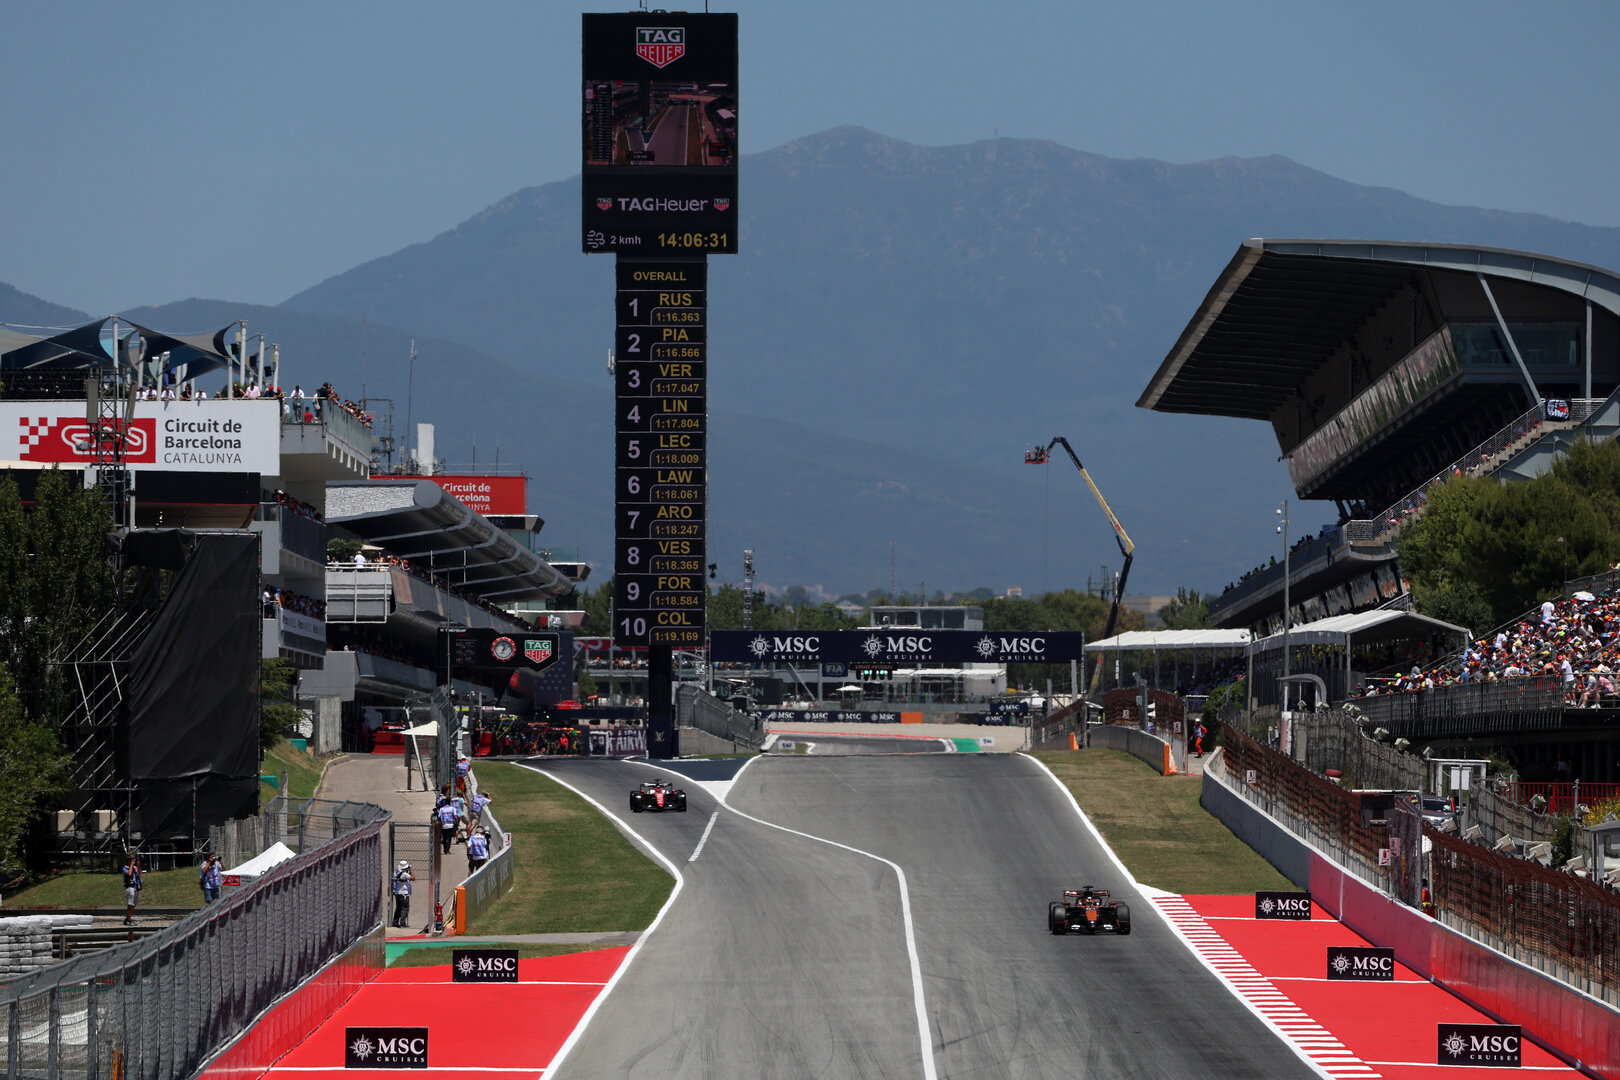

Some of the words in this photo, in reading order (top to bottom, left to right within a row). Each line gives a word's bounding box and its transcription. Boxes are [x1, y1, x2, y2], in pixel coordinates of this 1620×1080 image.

[640, 30, 681, 42] TAG
[639, 46, 682, 64] HEUER
[610, 236, 617, 244] 2
[619, 235, 641, 245] kmh
[658, 233, 727, 247] 14:06:31
[633, 272, 687, 281] OVERALL
[628, 298, 638, 317] 1
[660, 293, 692, 306] RUS
[656, 313, 700, 322] 1:16.363
[628, 334, 640, 352] 2
[663, 328, 688, 341] PIA
[656, 348, 700, 357] 1:16.566
[628, 370, 640, 388] 3
[660, 364, 692, 376] VER
[656, 384, 700, 392] 1:17.047
[628, 405, 640, 423] 4
[663, 400, 688, 412] LIN
[164, 418, 219, 433] Circuit
[222, 418, 242, 434] de
[656, 419, 700, 428] 1:17.804
[165, 435, 242, 449] Barcelona
[628, 440, 640, 459] 5
[660, 435, 691, 448] LEC
[164, 452, 242, 464] CATALUNYA
[656, 454, 698, 464] 1:18.009
[443, 483, 476, 492] Circuit
[478, 483, 491, 493] de
[628, 476, 640, 494] 6
[658, 470, 692, 483] LAW
[455, 493, 490, 502] rcelona
[656, 490, 698, 499] 1:18.061
[628, 511, 640, 530] 7
[657, 506, 692, 518] ARO
[656, 526, 698, 534] 1:18.247
[628, 546, 640, 565] 8
[659, 541, 691, 554] VES
[656, 560, 698, 570] 1:18.365
[627, 582, 640, 600] 9
[658, 576, 691, 589] FOR
[656, 596, 698, 605] 1:18.584
[620, 618, 646, 636] 10
[658, 612, 691, 625] COL
[655, 632, 698, 640] 1:19.169
[528, 641, 550, 649] TAG
[773, 637, 820, 652] MSC
[886, 636, 932, 652] MSC
[1000, 637, 1046, 653] MSC
[526, 650, 550, 661] HEUER
[826, 664, 843, 672] FIA
[812, 712, 828, 720] MSC
[1277, 899, 1309, 910] MSC
[478, 958, 516, 971] MSC
[1352, 956, 1392, 970] MSC
[377, 1038, 424, 1054] MSC
[1470, 1036, 1518, 1053] MSC
